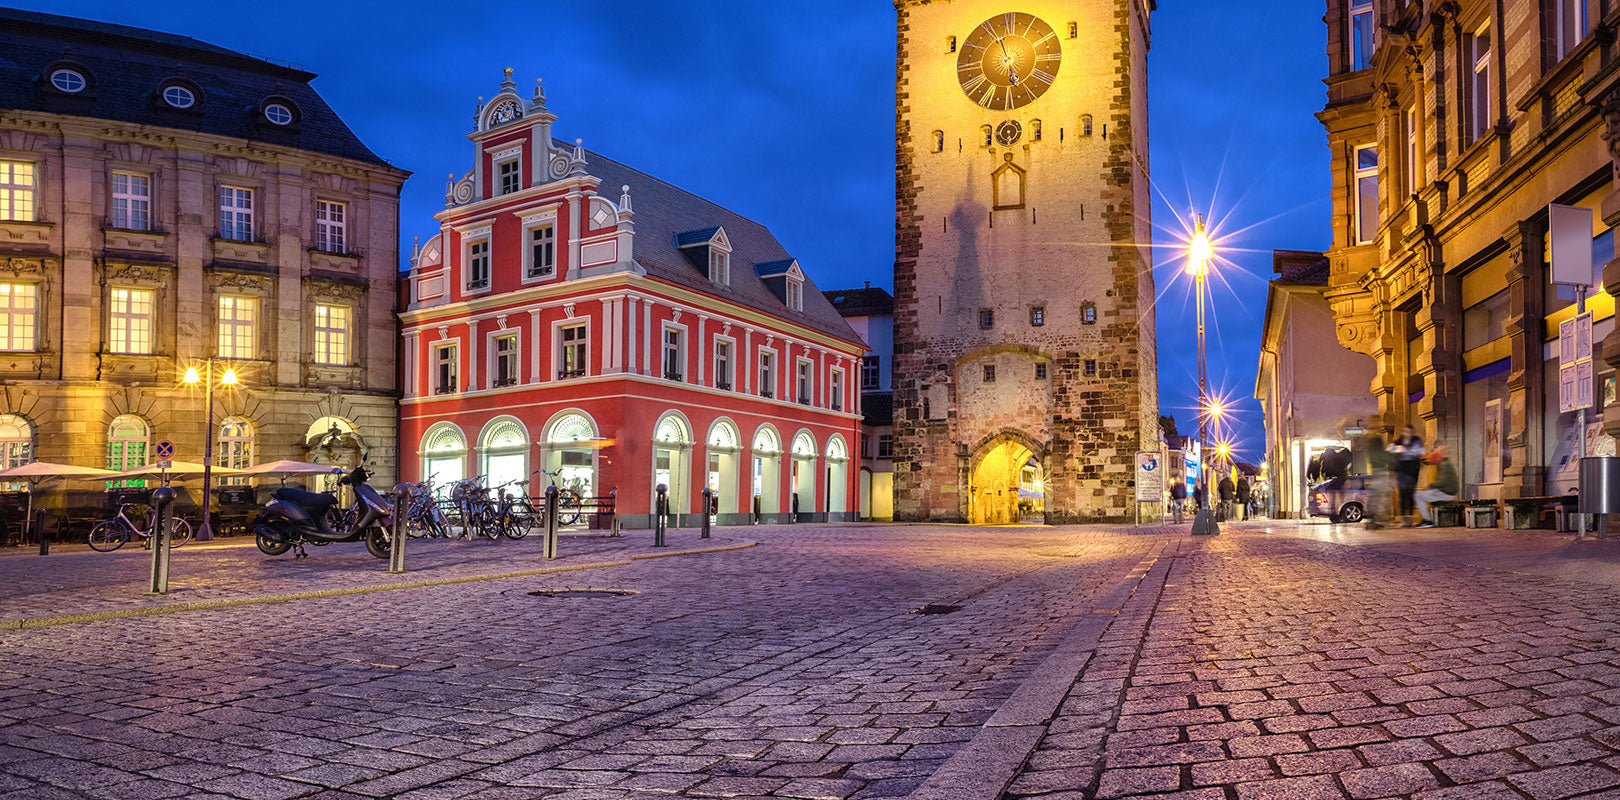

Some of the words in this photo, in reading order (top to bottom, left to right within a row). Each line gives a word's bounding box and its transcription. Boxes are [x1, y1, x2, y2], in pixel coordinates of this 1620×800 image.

[981, 20, 999, 41] XI
[1004, 12, 1016, 35] XII
[1022, 16, 1037, 38] I
[963, 40, 986, 53] X
[1032, 31, 1055, 47] II
[957, 60, 981, 71] IX
[1036, 53, 1061, 62] III
[1004, 86, 1015, 110] VI
[1022, 82, 1038, 102] V
